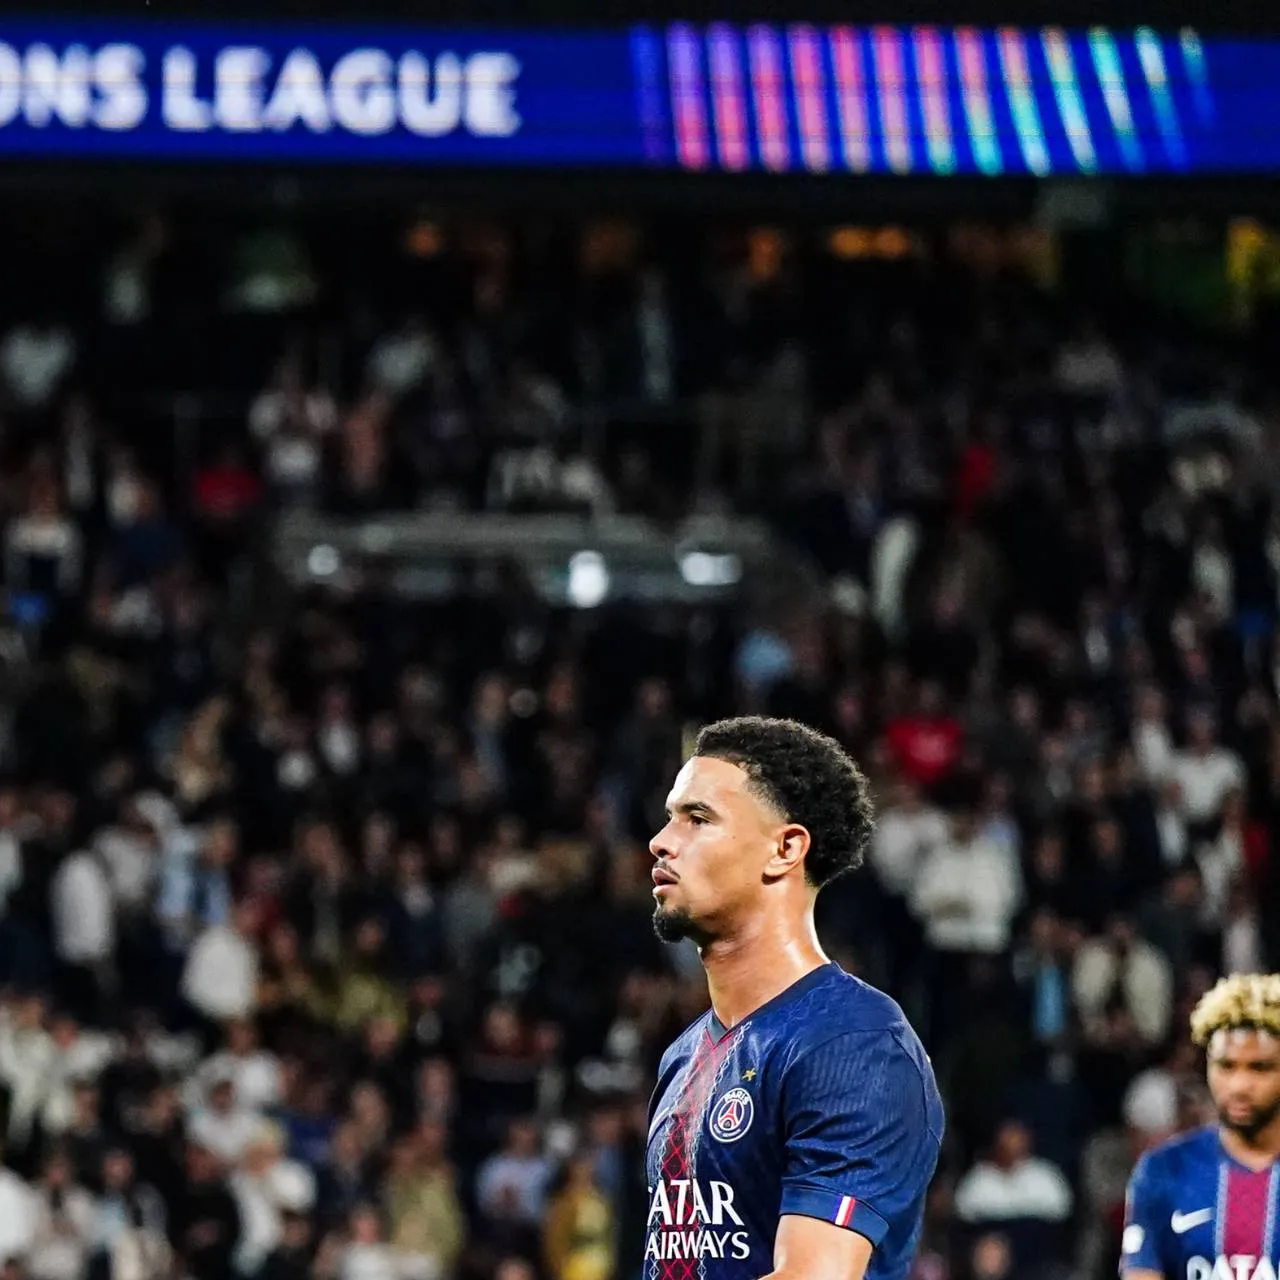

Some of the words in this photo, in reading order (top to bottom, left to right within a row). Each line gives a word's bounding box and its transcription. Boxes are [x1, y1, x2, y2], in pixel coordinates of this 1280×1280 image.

[163, 46, 524, 137] LEAGUE
[647, 1179, 745, 1226] ATAR
[644, 1231, 751, 1260] AIRWAYS
